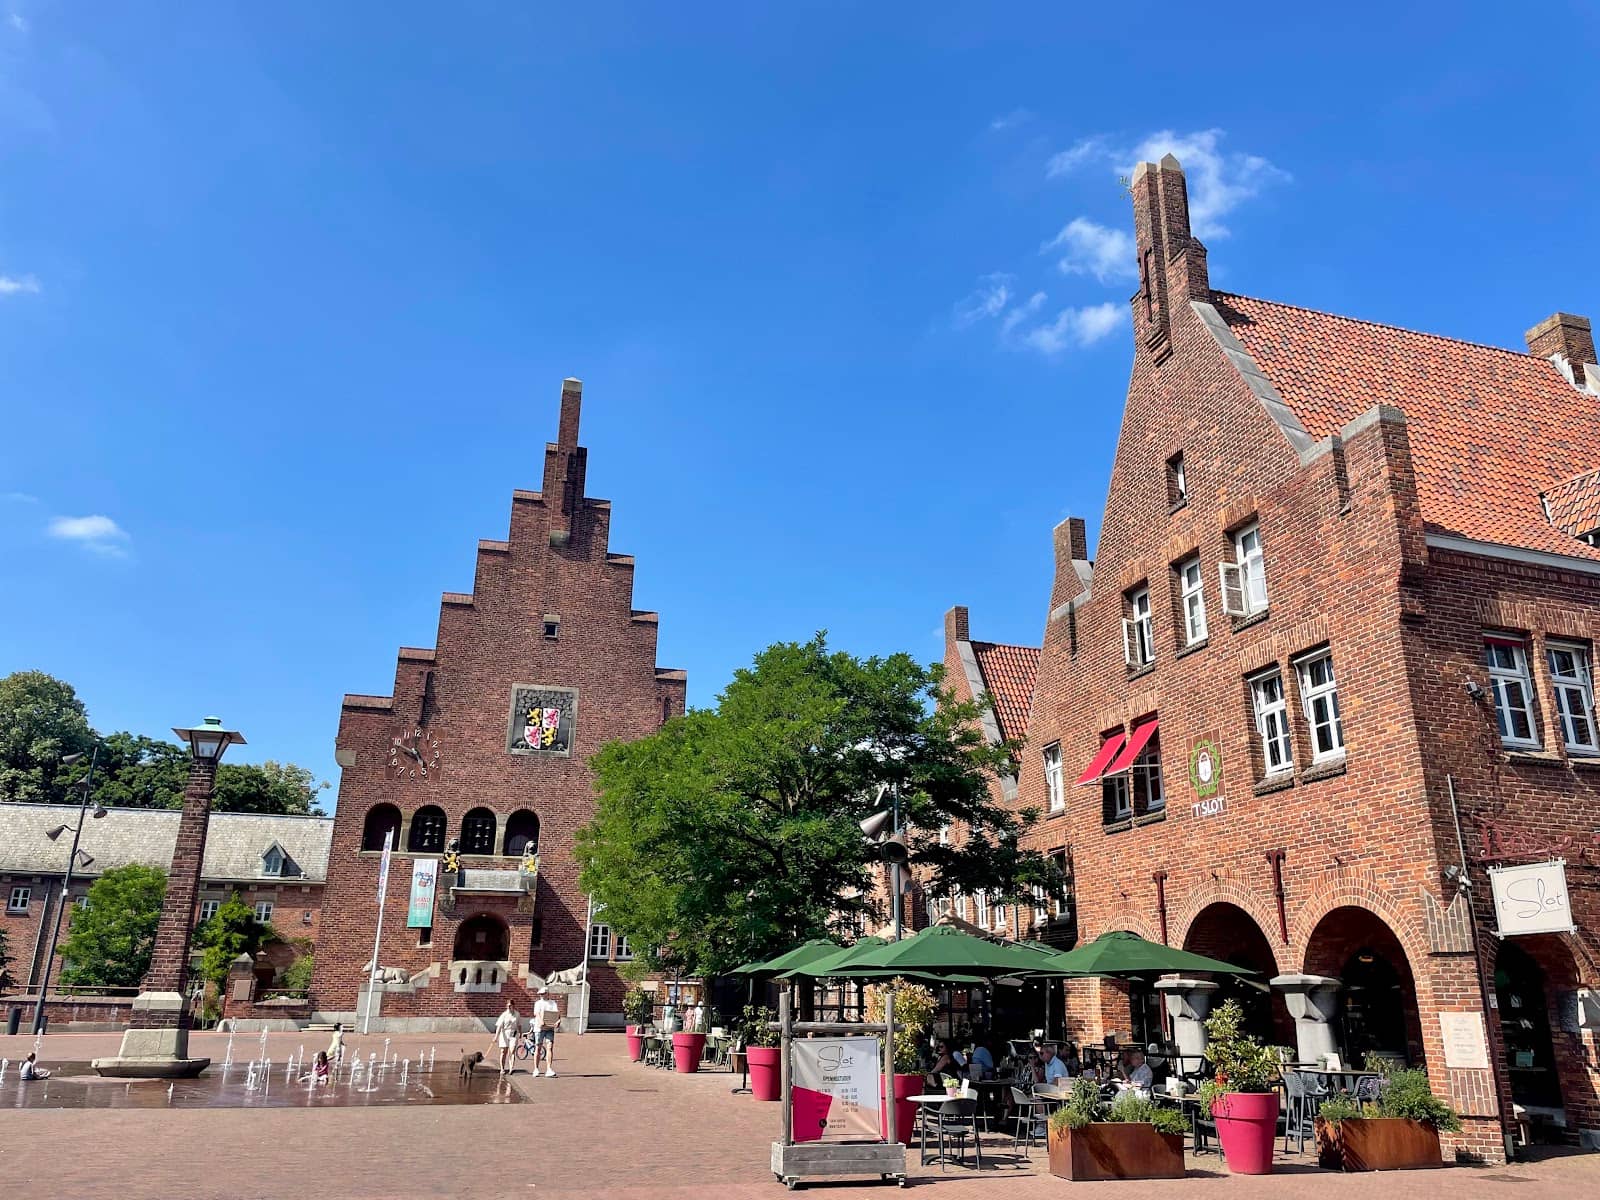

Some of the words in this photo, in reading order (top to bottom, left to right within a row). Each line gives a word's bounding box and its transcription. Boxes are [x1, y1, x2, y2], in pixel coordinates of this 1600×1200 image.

[403, 731, 410, 739] 11
[414, 728, 422, 737] 12
[432, 740, 438, 748] 2
[390, 748, 397, 756] 9
[391, 758, 398, 766] 8
[429, 760, 436, 768] 4
[399, 766, 405, 774] 7
[409, 769, 416, 777] 6
[420, 767, 427, 775] 5
